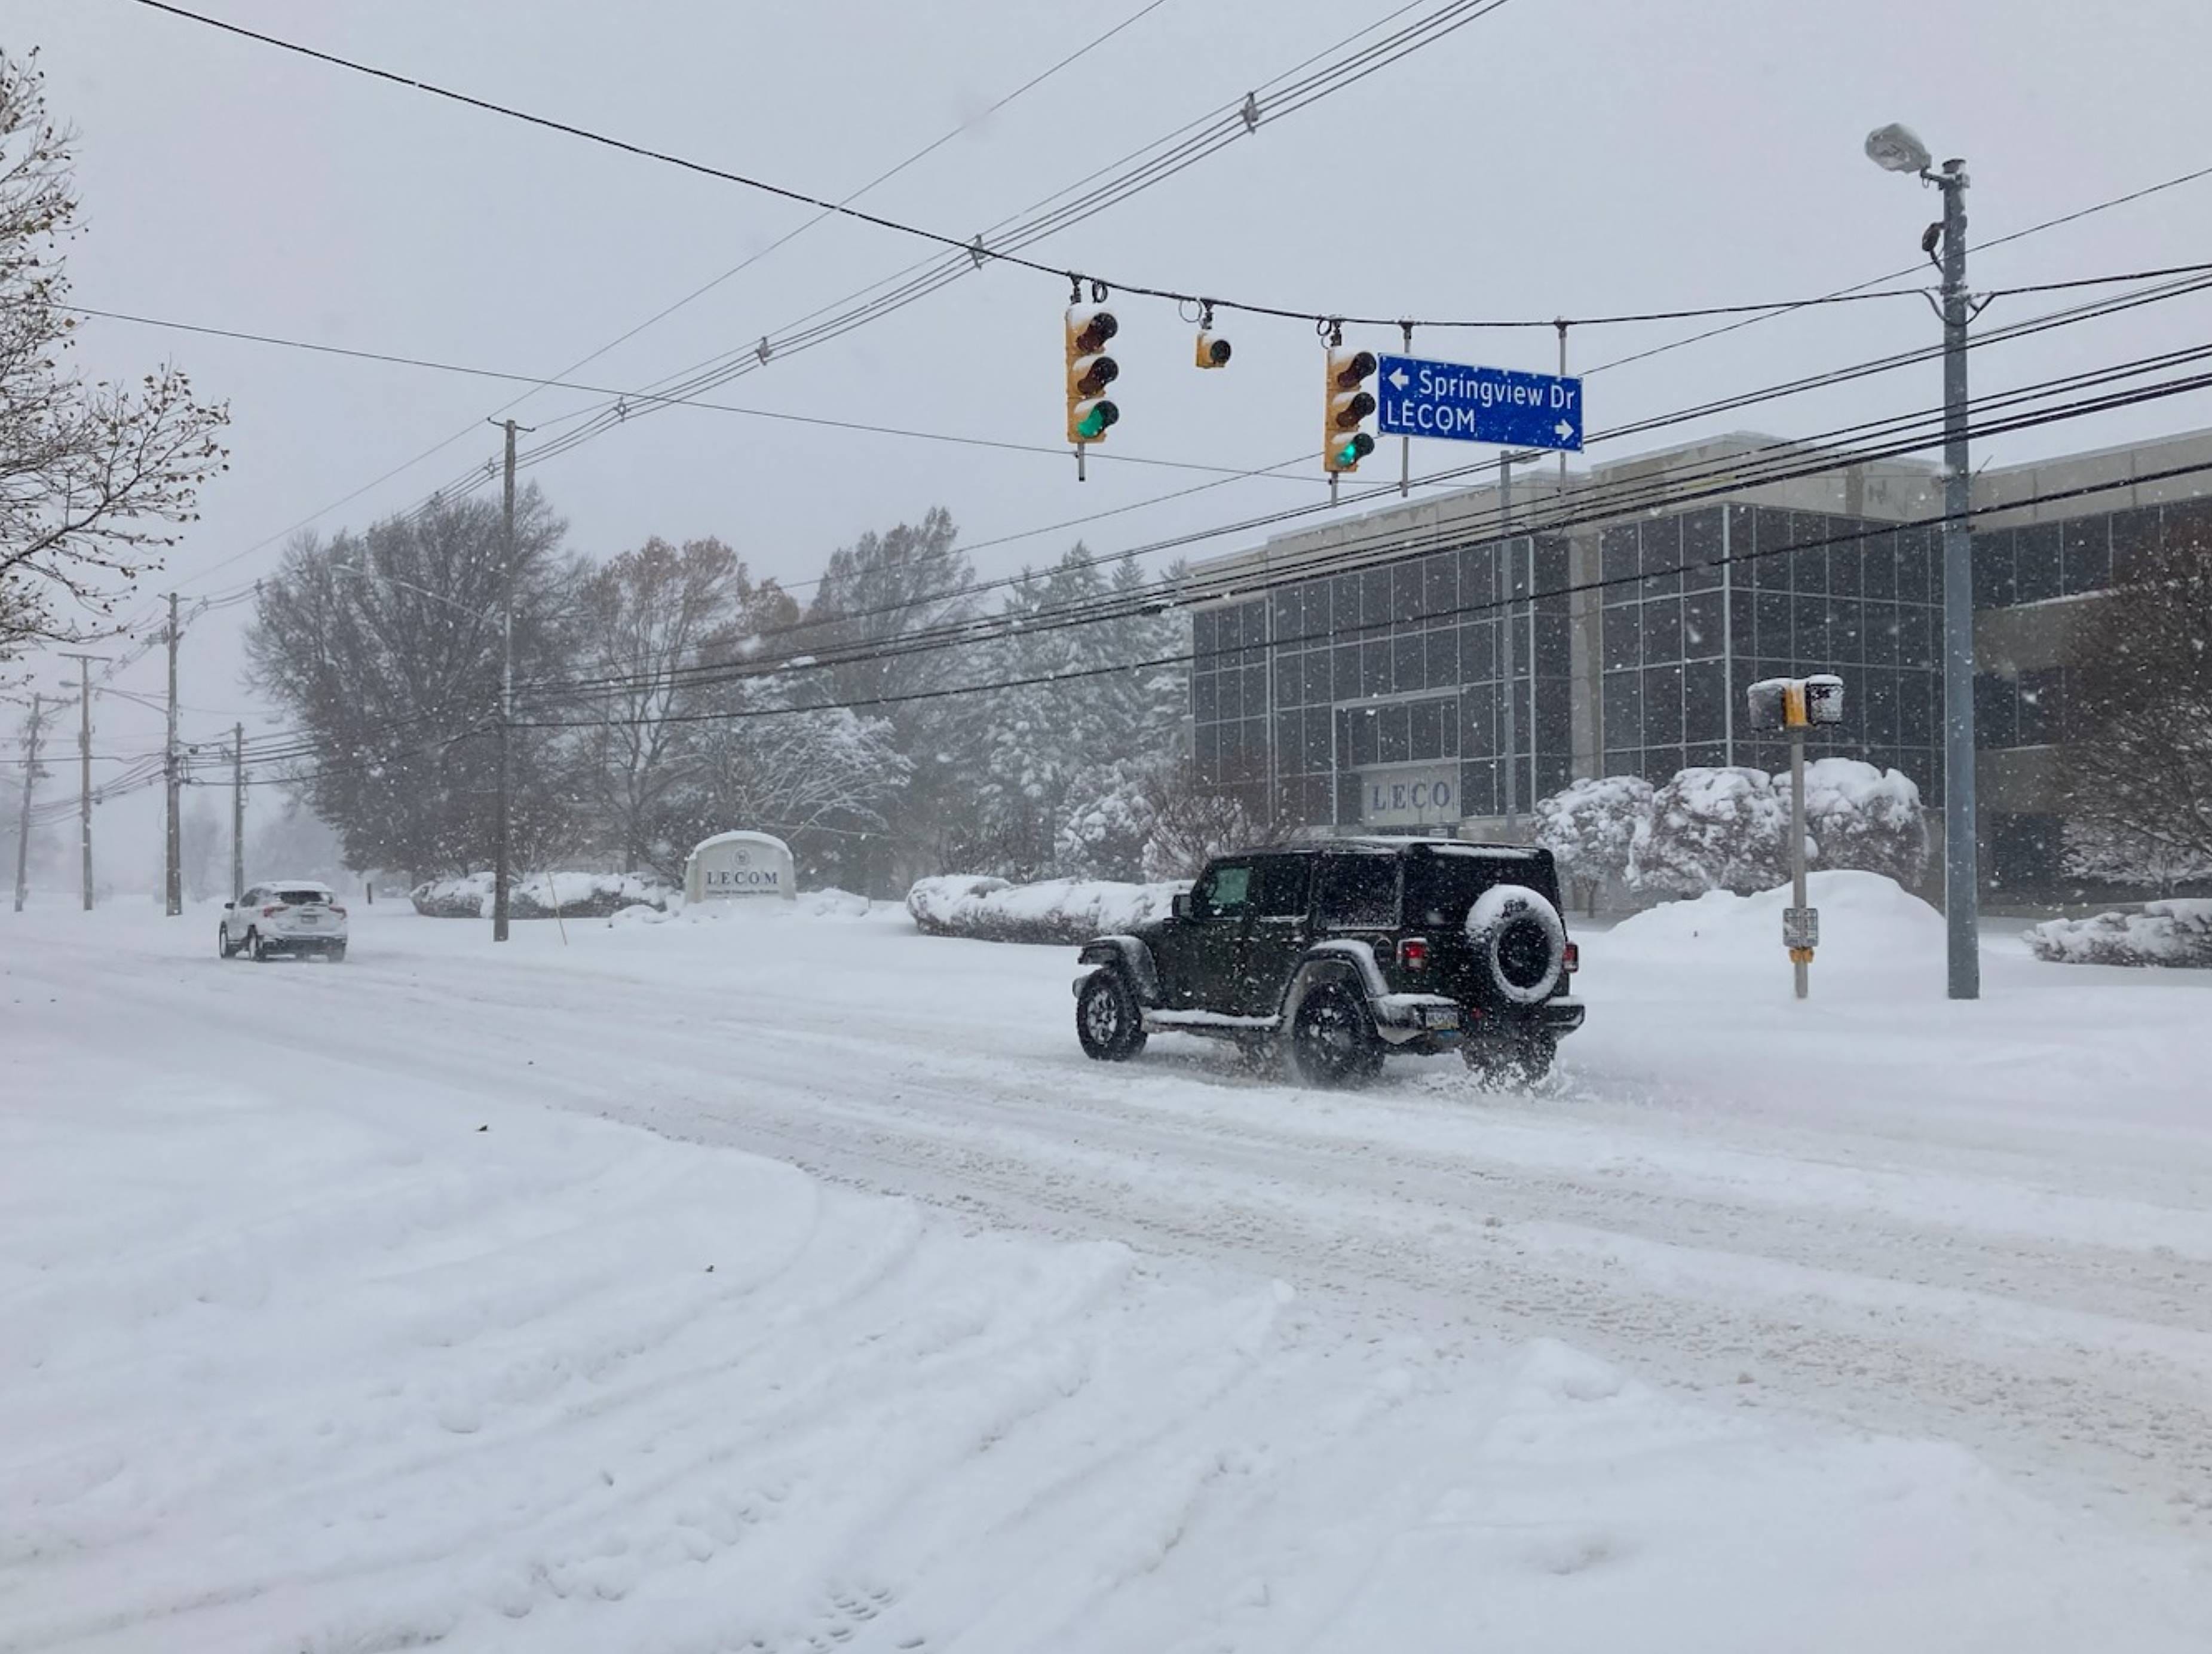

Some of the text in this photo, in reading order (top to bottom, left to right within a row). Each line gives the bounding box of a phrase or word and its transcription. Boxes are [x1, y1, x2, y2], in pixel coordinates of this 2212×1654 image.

[1419, 370, 1576, 409] Springview Dr
[1387, 399, 1475, 433] LECOM
[1372, 781, 1459, 810] LECO
[707, 871, 778, 884] LECOM
